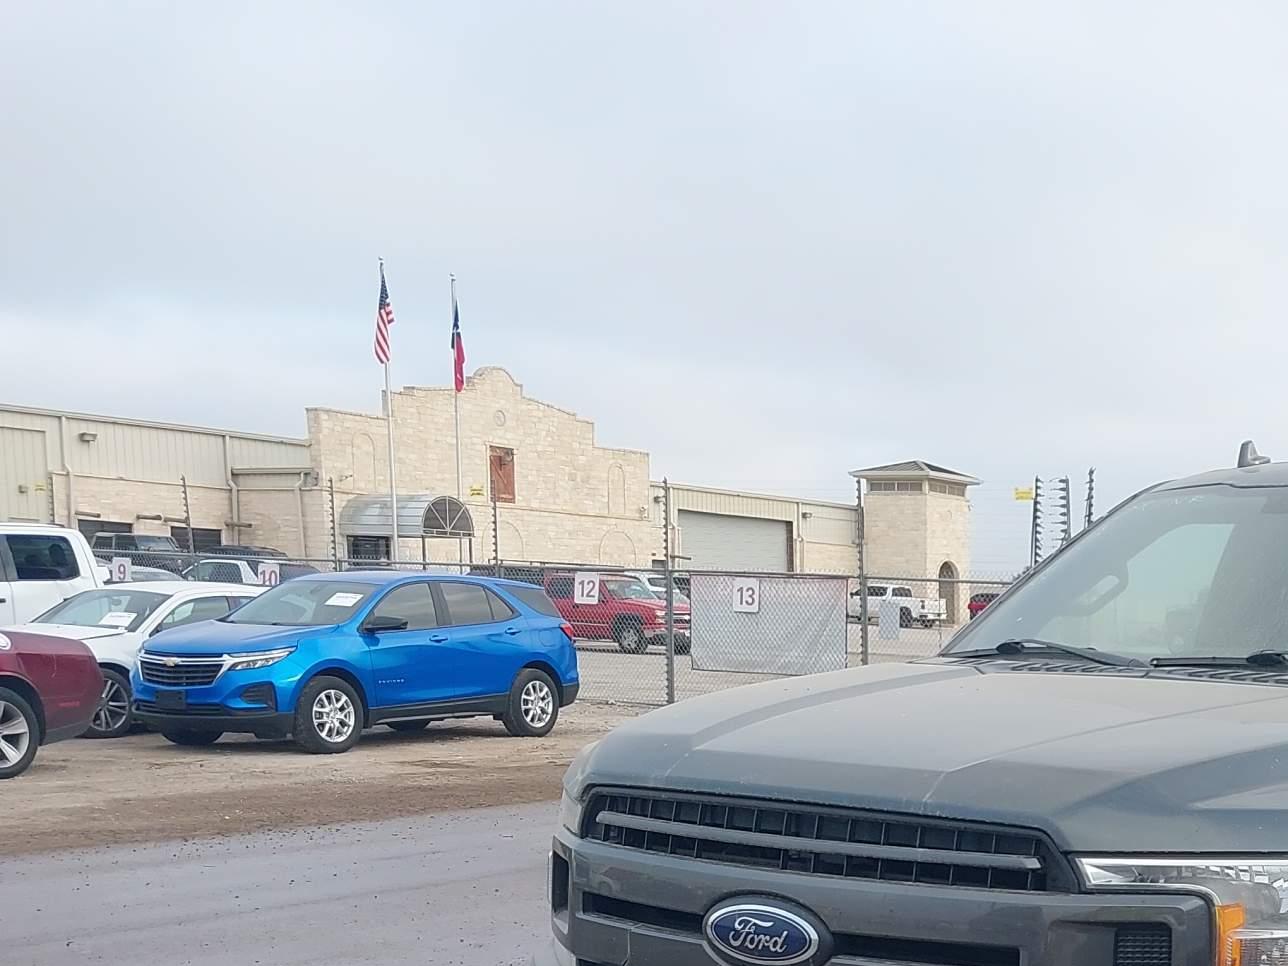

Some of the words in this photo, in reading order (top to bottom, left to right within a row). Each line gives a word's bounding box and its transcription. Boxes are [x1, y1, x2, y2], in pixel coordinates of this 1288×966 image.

[117, 563, 127, 581] 9
[259, 569, 278, 586] 10
[577, 579, 596, 598] 12
[736, 586, 756, 606] 13
[728, 916, 788, 953] Ford
